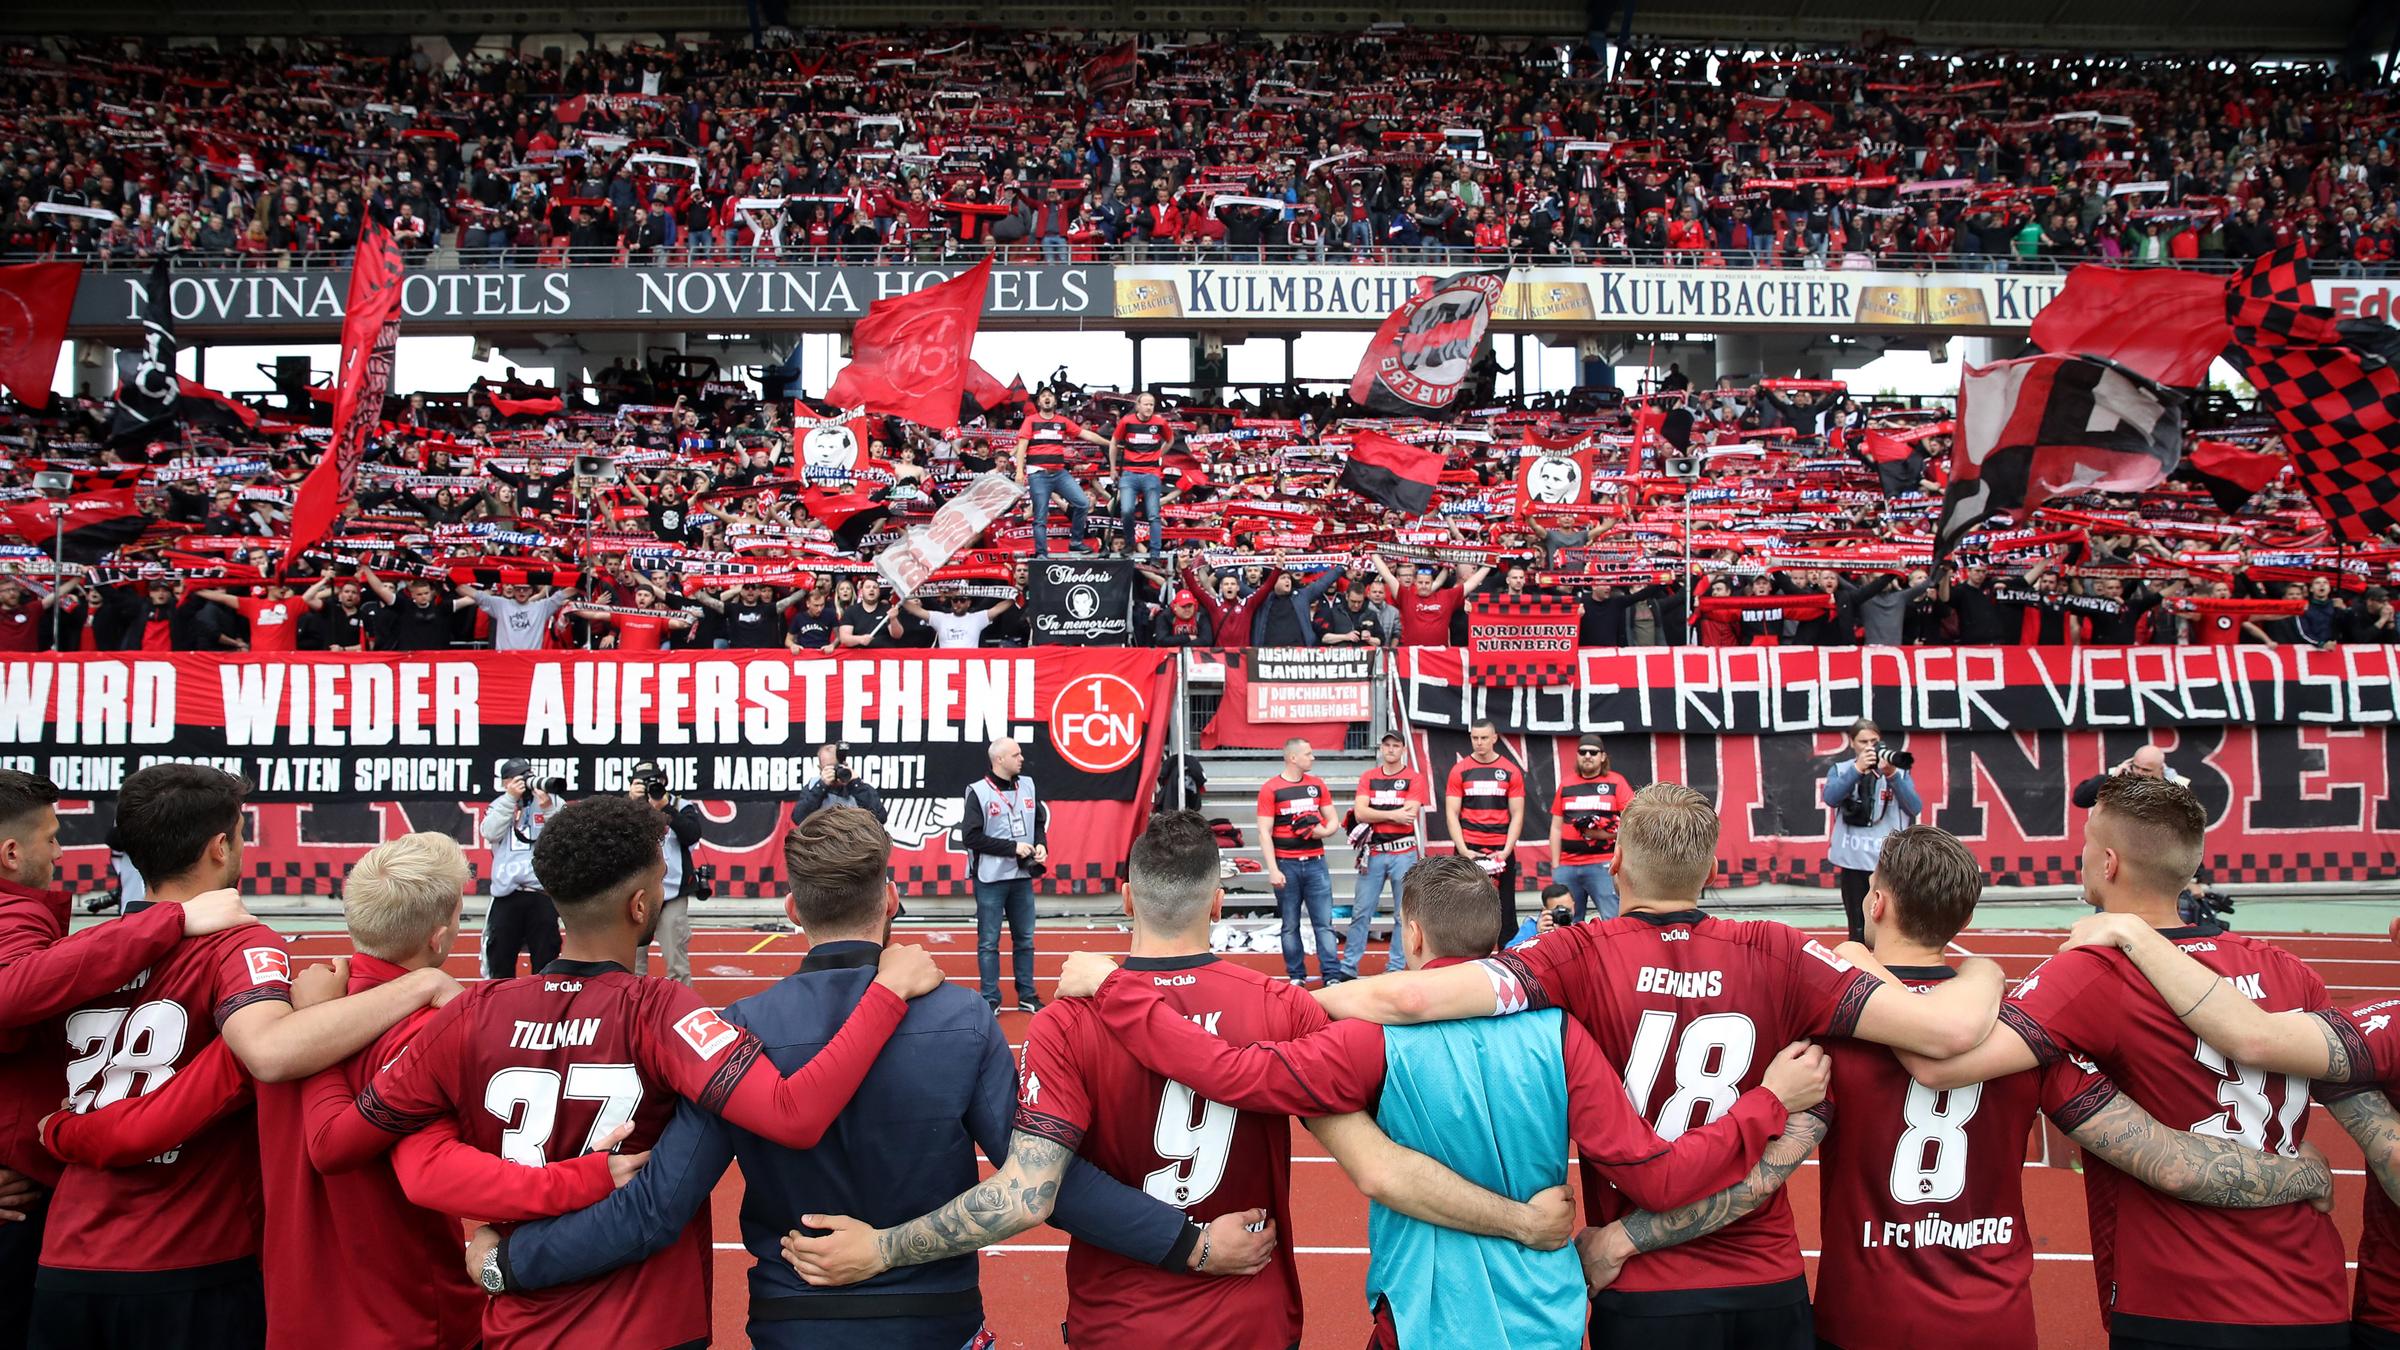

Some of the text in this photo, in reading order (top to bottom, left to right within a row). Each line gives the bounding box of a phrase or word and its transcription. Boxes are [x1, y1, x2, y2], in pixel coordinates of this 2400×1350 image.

[124, 272, 571, 319] NOVINA OTELS
[636, 270, 861, 313] NOVINA
[1600, 272, 1852, 318] KULMBACHER
[1045, 564, 1113, 585] Thodoris
[1037, 614, 1126, 632] In memoriam
[1471, 624, 1577, 639] NORDKURVE
[1258, 664, 1369, 680] BANNMEILE
[2027, 644, 2285, 726] VEREIN
[0, 658, 1035, 746] WIRD WIEDER AUFERSTEHEN!
[1087, 680, 1110, 714] 1.
[1270, 703, 1359, 718] NO SURRENDER
[1271, 686, 1358, 701] DURCHHALTEN
[1061, 711, 1136, 749] FCN
[49, 755, 126, 791] DEINE
[257, 756, 341, 793] TATEN
[354, 756, 480, 796] SPRICHT,
[1671, 928, 1690, 941] Club
[2178, 941, 2217, 954] Der Club
[544, 980, 583, 993] Der Club
[1154, 974, 1196, 987] Der Club
[509, 1017, 602, 1051] TILLMAN
[1623, 1008, 1757, 1143] 18
[484, 1062, 645, 1169] 37
[1143, 1078, 1238, 1210] 9
[1889, 1077, 1984, 1206] 8
[1883, 1221, 1910, 1247] FC
